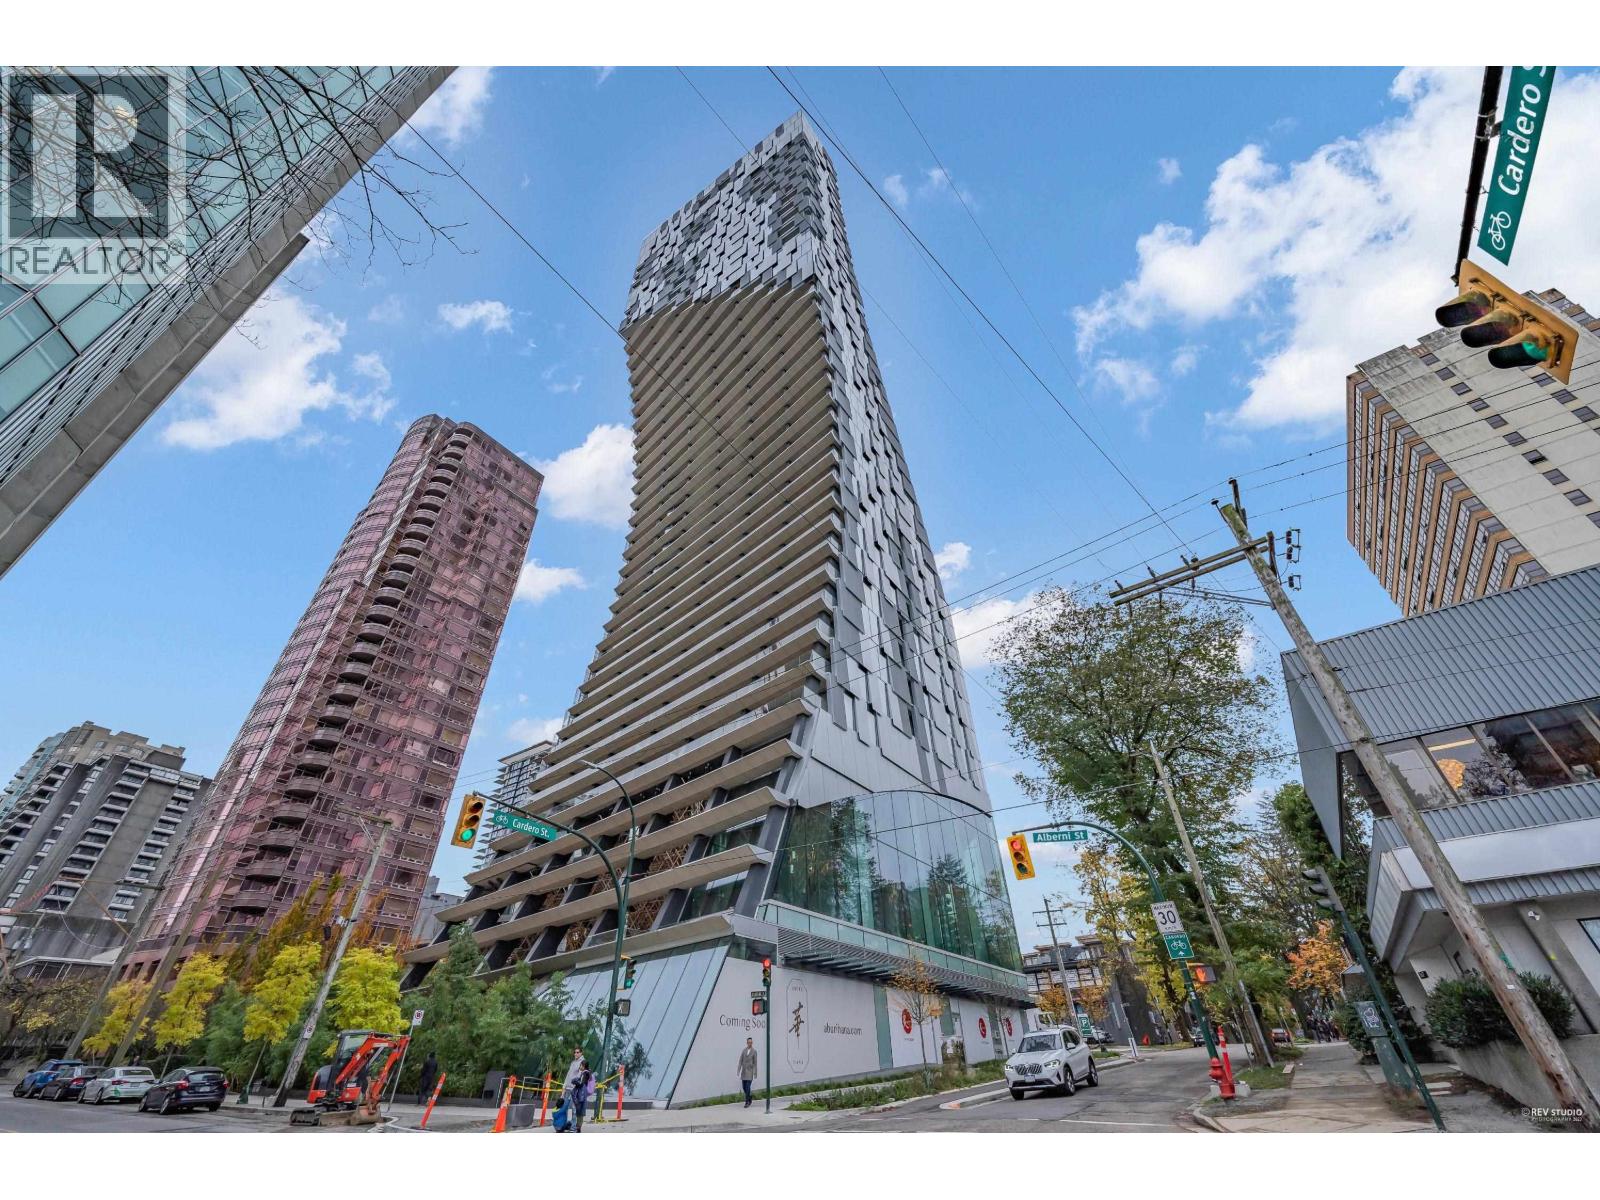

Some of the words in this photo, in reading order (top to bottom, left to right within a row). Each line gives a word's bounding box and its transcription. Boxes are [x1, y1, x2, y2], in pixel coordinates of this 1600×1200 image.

[1498, 83, 1541, 196] Cardero
[513, 819, 539, 834] Cardero
[541, 827, 549, 838] St.
[1038, 832, 1071, 841] Alberni
[1074, 832, 1085, 840] St
[1158, 910, 1176, 925] 30
[719, 1014, 751, 1031] Coming
[751, 1017, 767, 1029] Soo
